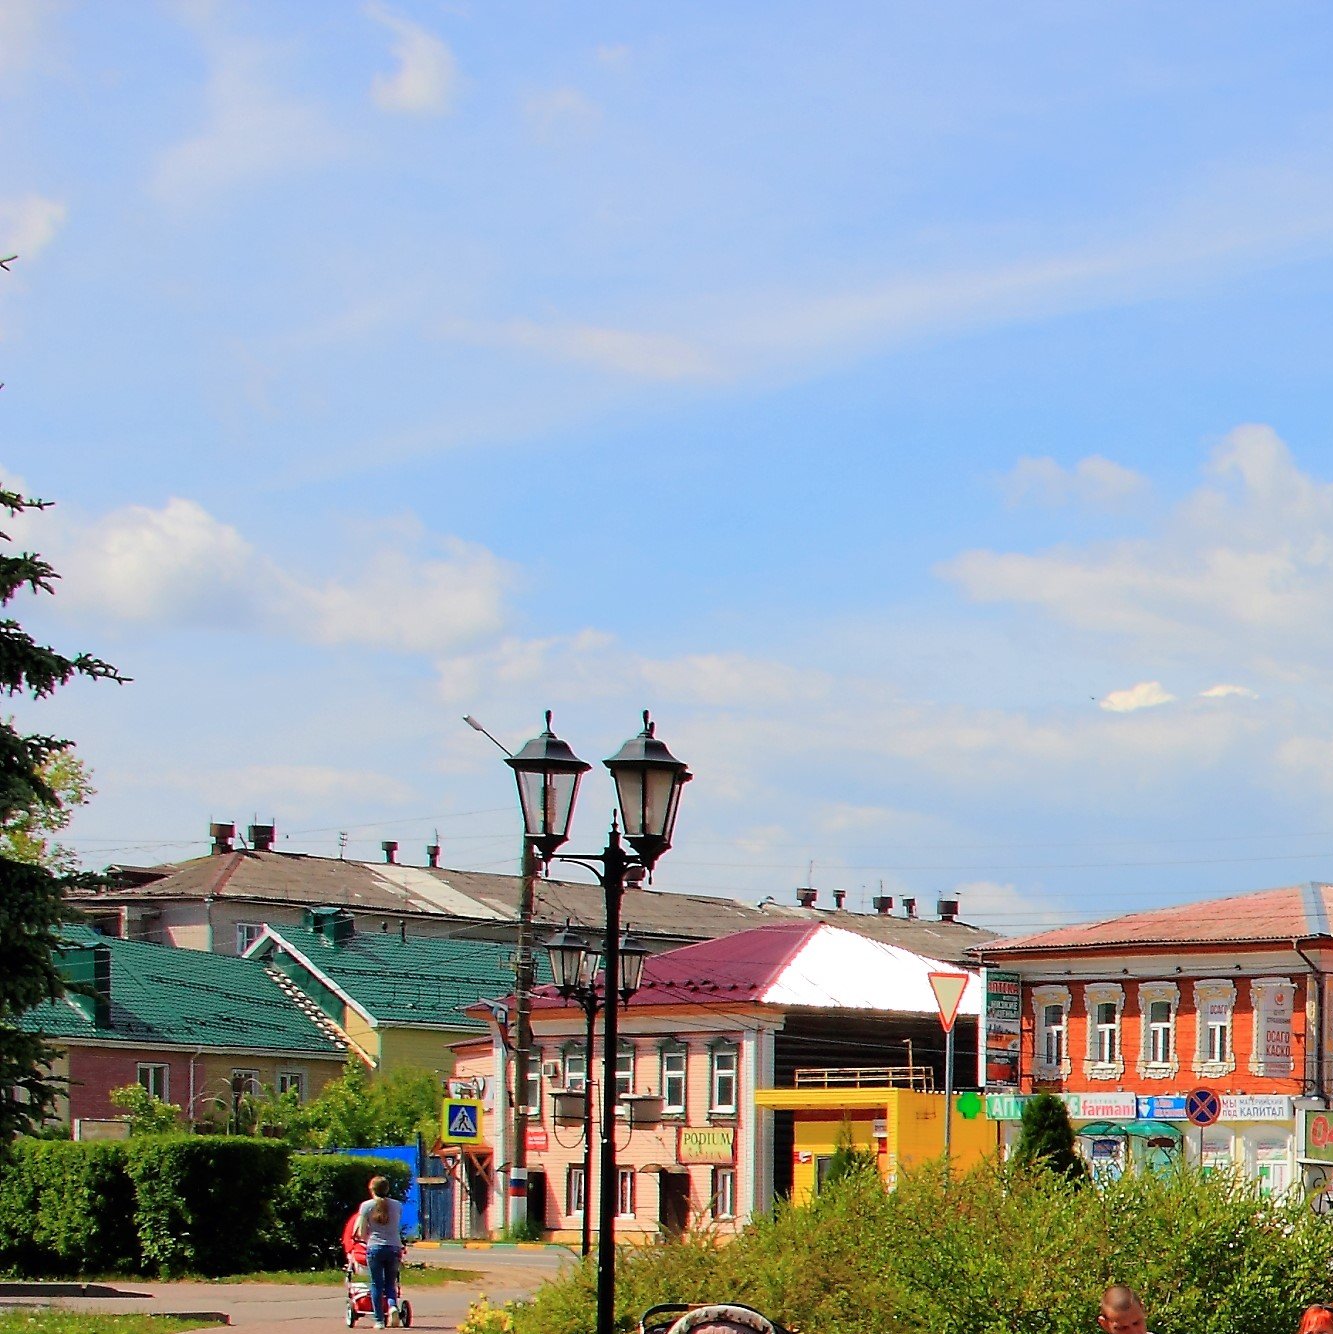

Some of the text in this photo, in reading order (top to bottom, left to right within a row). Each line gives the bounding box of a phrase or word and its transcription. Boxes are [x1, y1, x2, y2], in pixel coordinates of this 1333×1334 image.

[1266, 1030, 1290, 1044] ОСАГО
[1266, 1045, 1291, 1058] КАСКО
[1082, 1100, 1134, 1116] farmani
[1240, 1106, 1285, 1117] КАПИТАЛ
[684, 1132, 731, 1145] PODIUM
